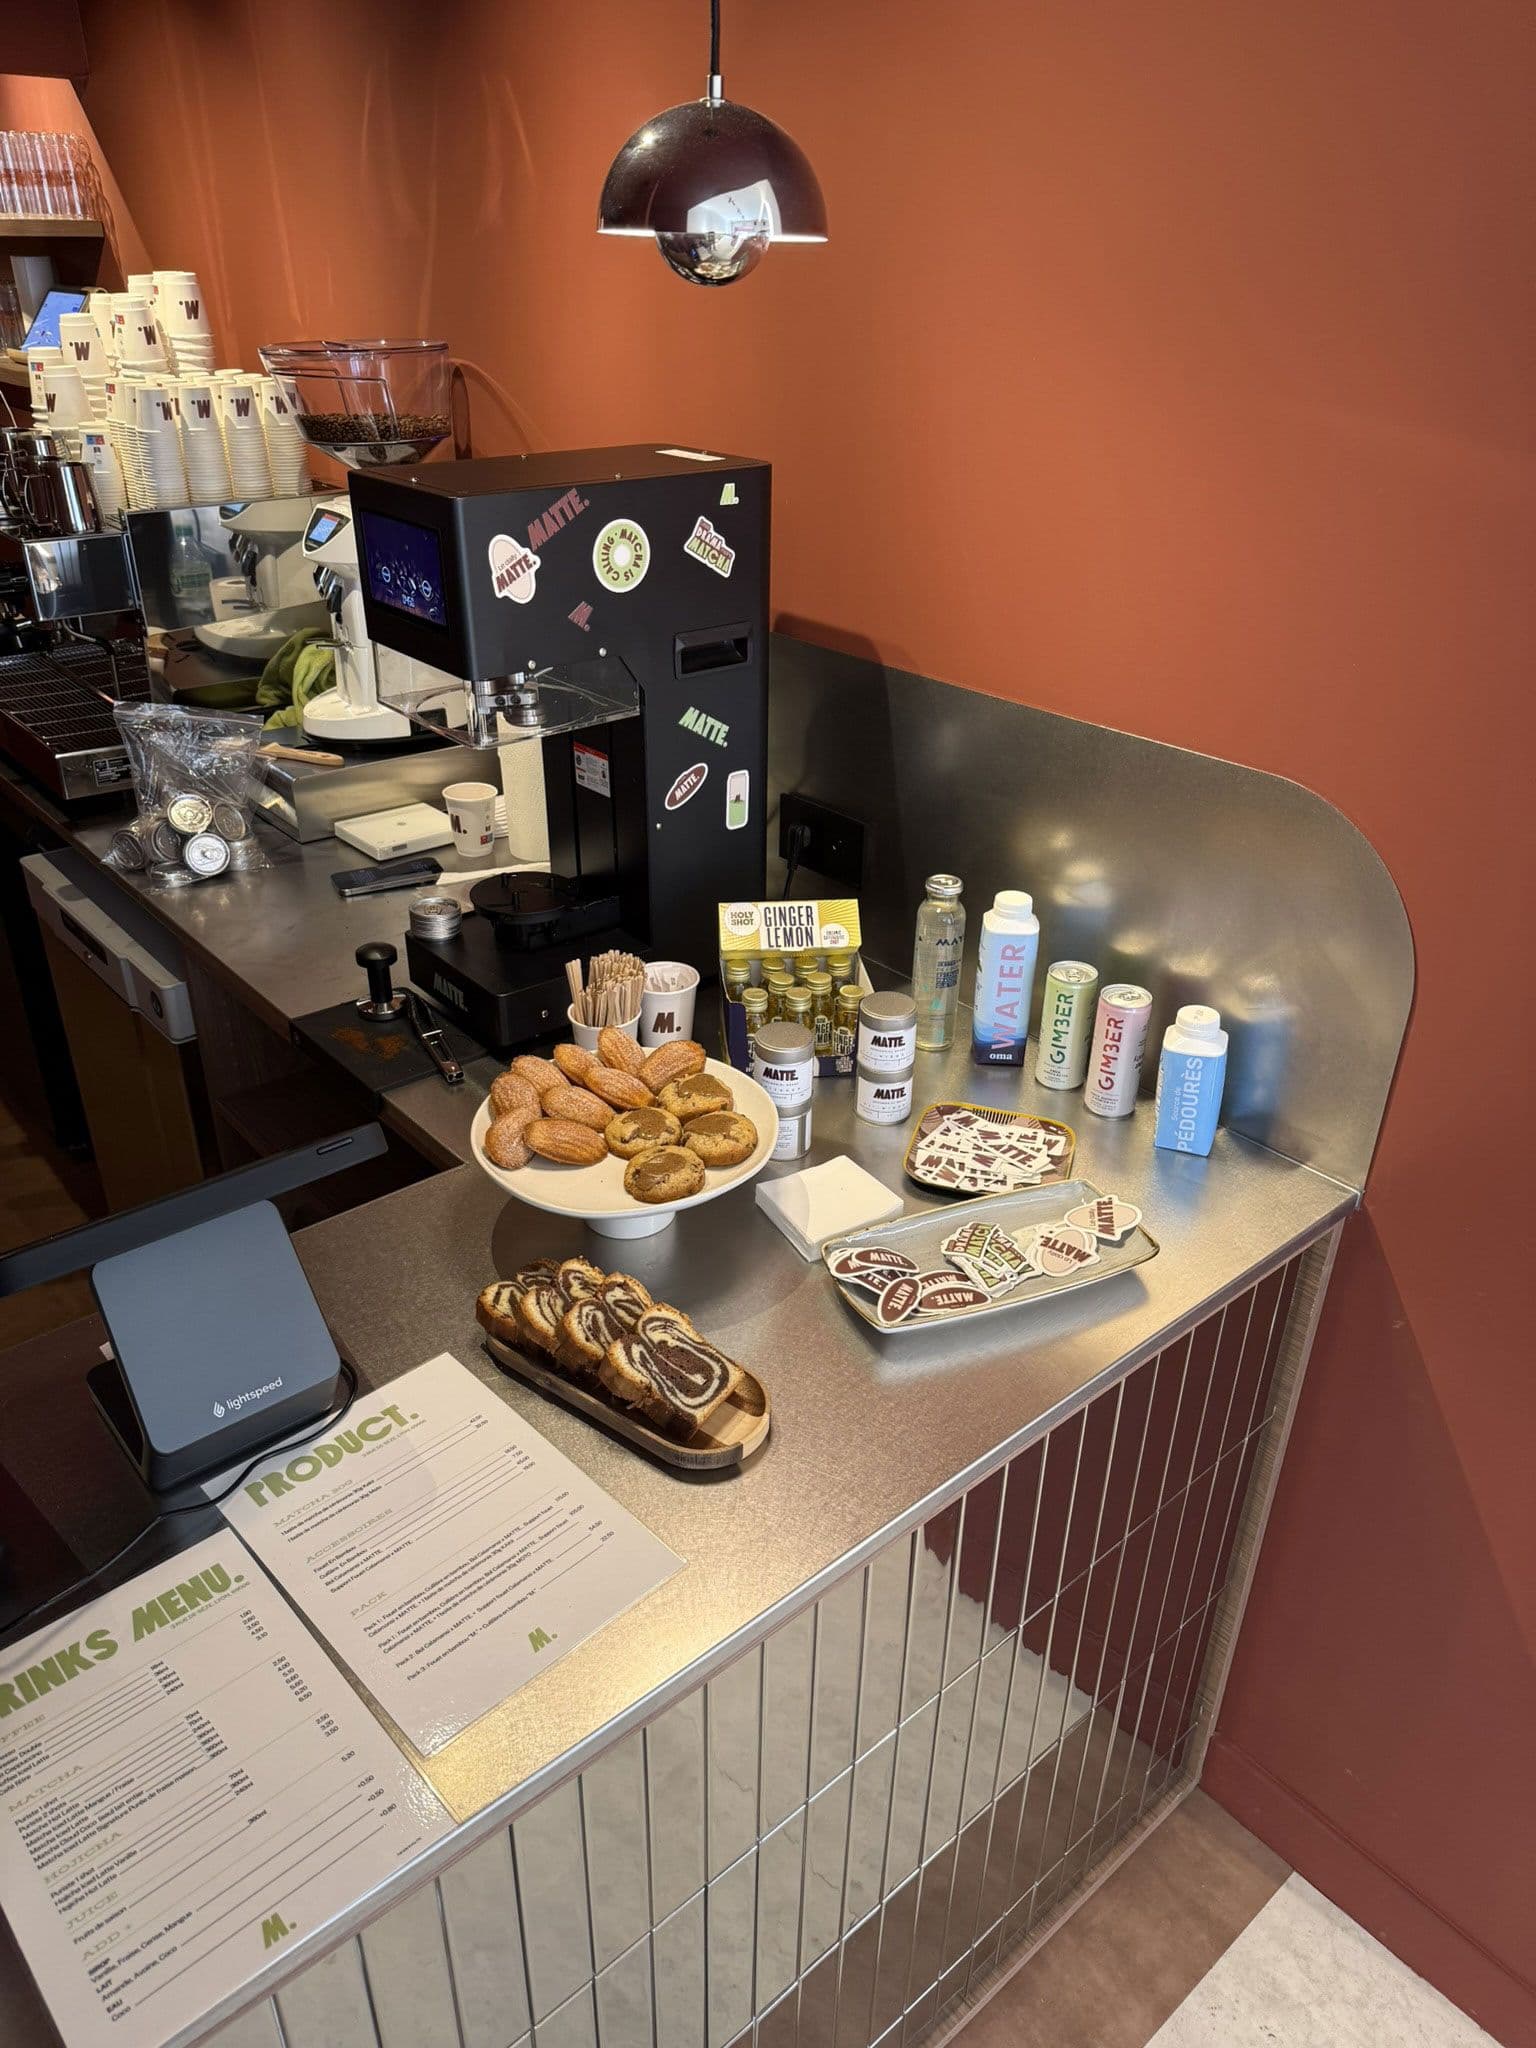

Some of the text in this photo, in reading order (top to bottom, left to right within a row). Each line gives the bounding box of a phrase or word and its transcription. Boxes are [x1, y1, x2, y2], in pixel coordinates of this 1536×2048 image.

[527, 488, 590, 552] MATTE.
[495, 554, 537, 593] MATTE.
[601, 528, 643, 582] MATCHA IS CALLING
[687, 536, 731, 574] MATCHA
[678, 706, 730, 748] MATTE.
[674, 773, 700, 801] MATTE.
[730, 911, 754, 919] HOLY
[763, 905, 815, 927] GINGER
[767, 926, 815, 948] LEMON
[991, 944, 1026, 1049] WATER
[653, 1012, 682, 1033] M.
[1177, 1058, 1203, 1151] PÉDOURÈS
[1097, 1197, 1115, 1236] MATTE.
[870, 1252, 908, 1267] MATTE.
[1040, 1235, 1091, 1263] MATTE.
[887, 1283, 913, 1310] MATTE.
[931, 1292, 974, 1305] MATTE.
[226, 1377, 283, 1410] lightspeed
[244, 1404, 419, 1507] PRODUCT.
[350, 1591, 387, 1615] PACK
[0, 1629, 118, 1718] RINKS
[131, 1563, 244, 1642] MENU.
[528, 1626, 558, 1653] M.
[7, 1763, 83, 1812] MATCHA
[22, 1821, 48, 1840] Matcha
[61, 1801, 80, 1815] Latte
[25, 1828, 52, 1847] Matcha
[66, 1807, 85, 1822] Latte
[29, 1836, 56, 1855] Matcha
[70, 1815, 89, 1829] Latte
[33, 1843, 59, 1863] Matcha
[36, 1850, 63, 1870] Matcha
[78, 1829, 96, 1844] Latte
[43, 1829, 121, 1884] HOJICHA
[65, 1890, 117, 1930] JUICE
[81, 1929, 121, 1961] ADD
[261, 1911, 297, 1950] M.
[96, 1978, 113, 1993] LAIT
